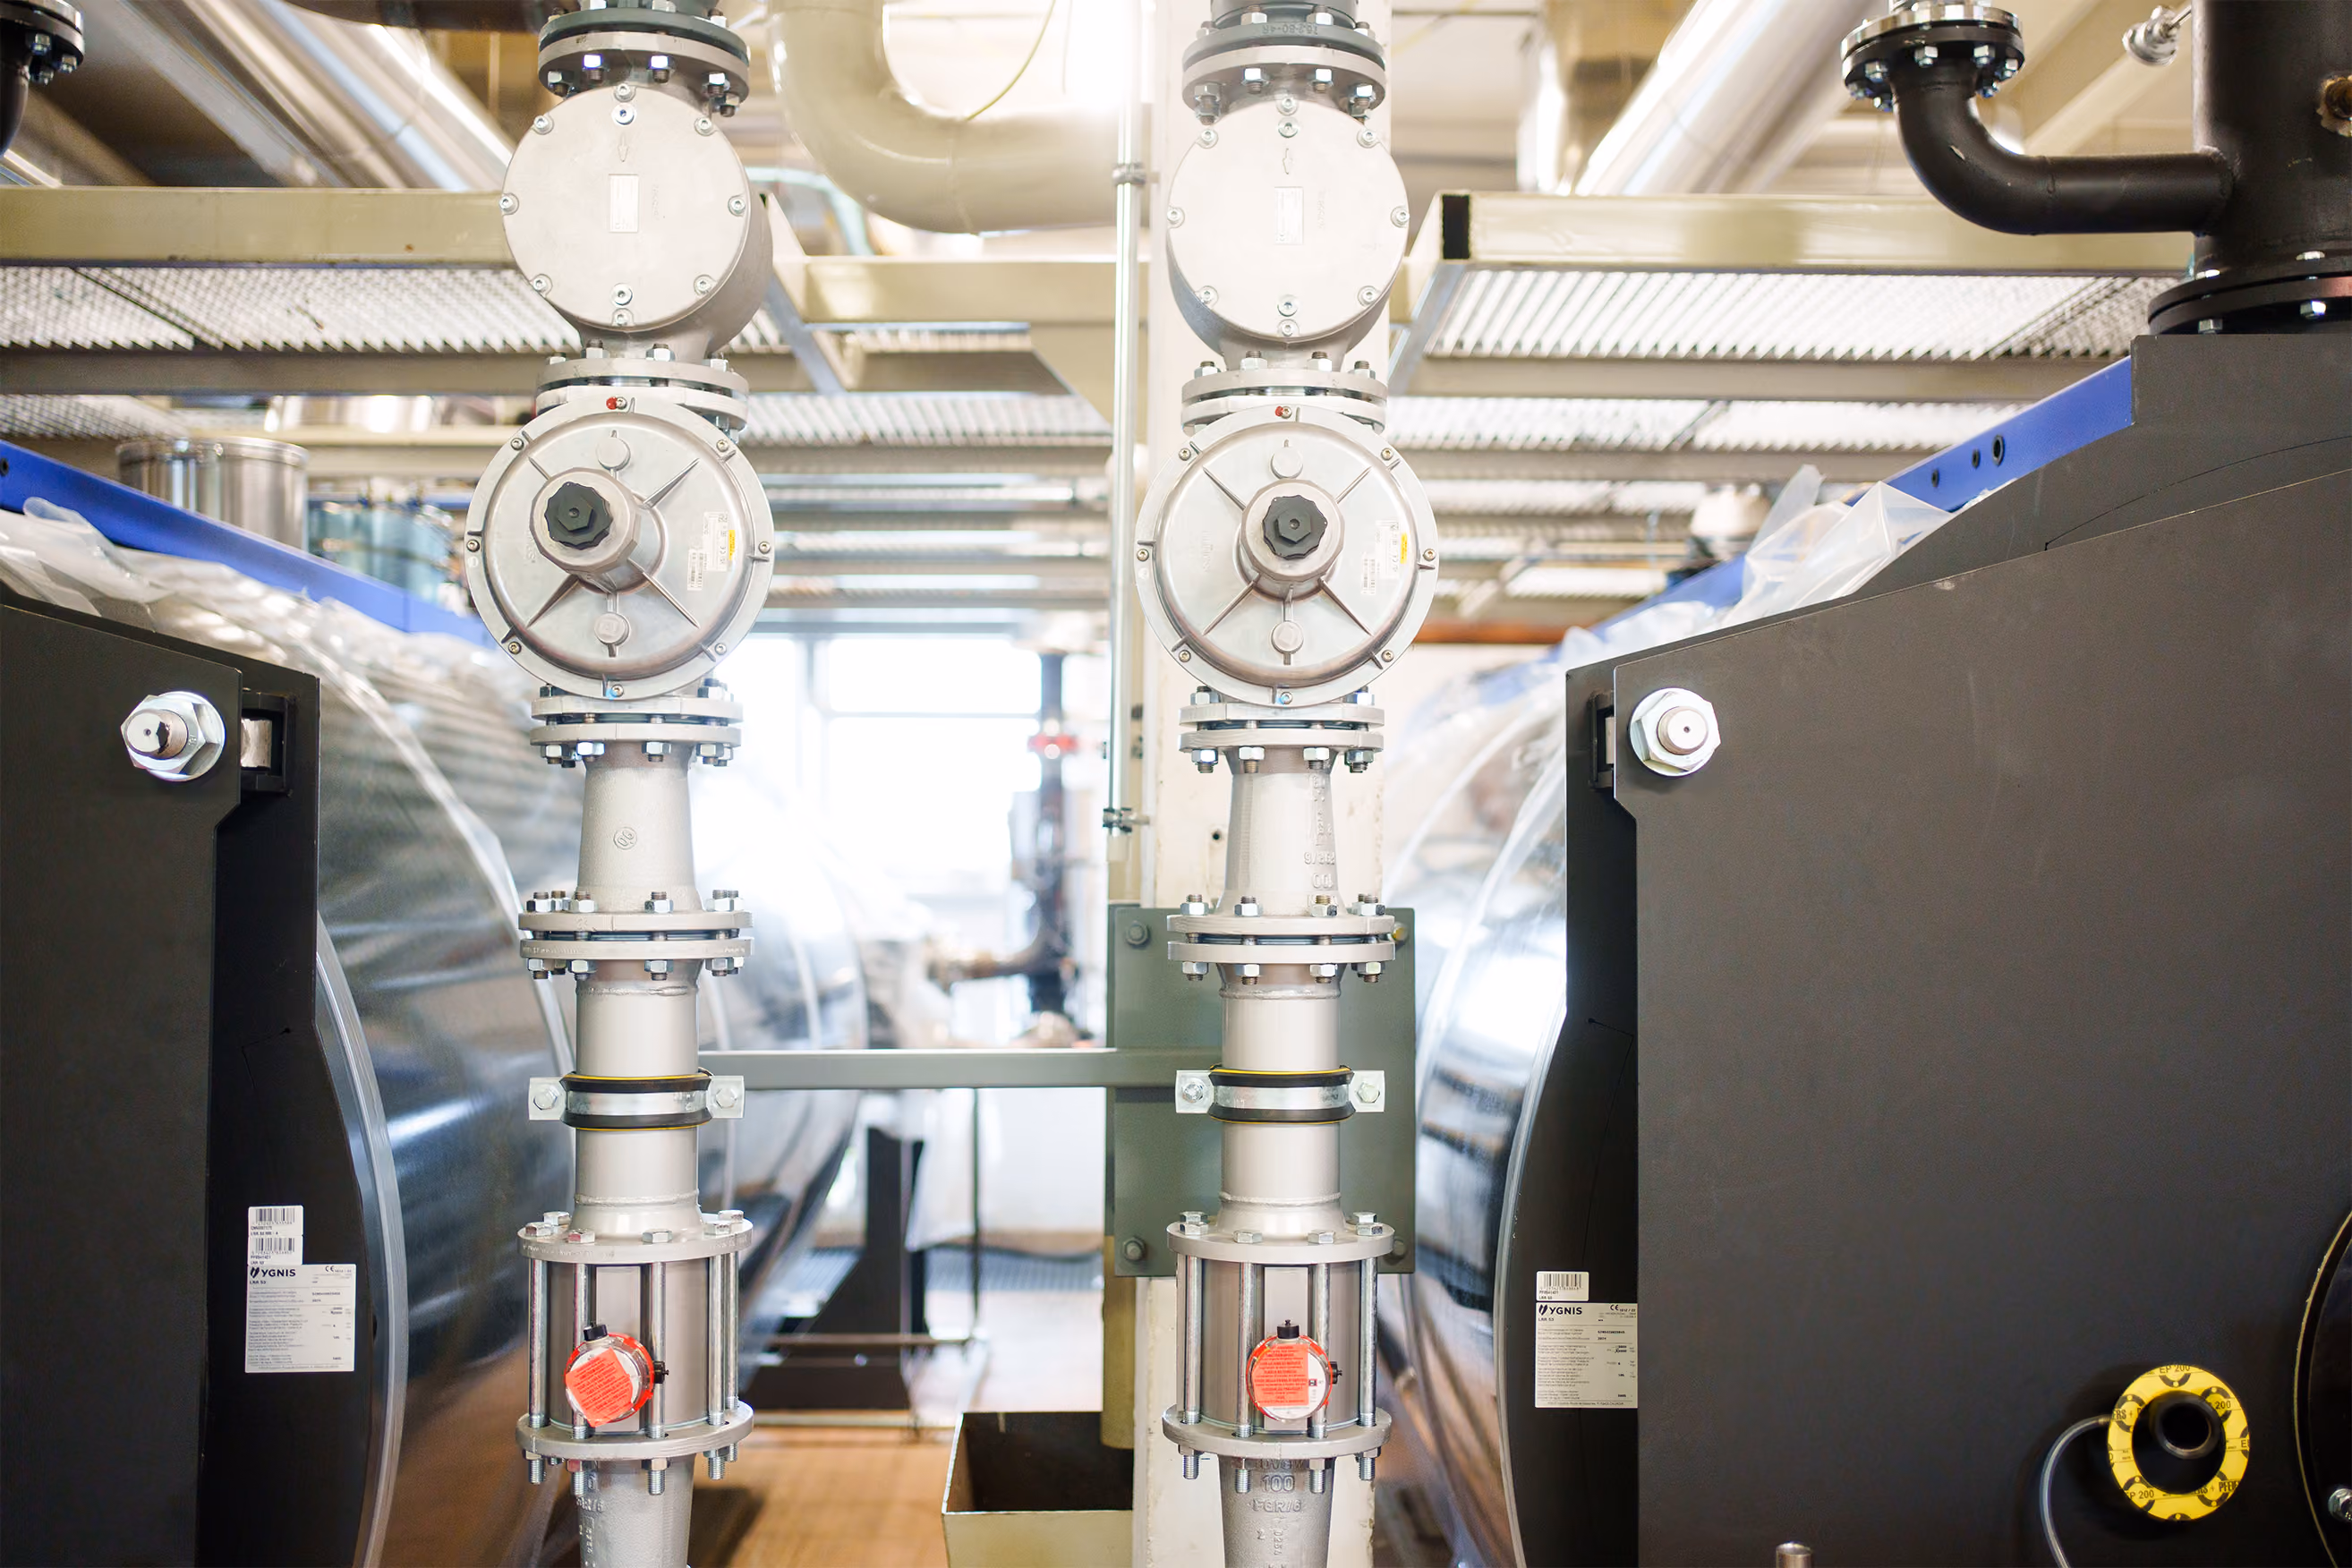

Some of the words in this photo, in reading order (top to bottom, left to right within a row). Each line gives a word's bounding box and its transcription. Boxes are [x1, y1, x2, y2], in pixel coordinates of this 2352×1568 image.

[261, 1269, 296, 1277] YGNIS
[1549, 1307, 1582, 1315] YGNIS
[2214, 1401, 2231, 1410] 200
[1262, 1474, 1295, 1493] 100
[2138, 1489, 2155, 1500] 200
